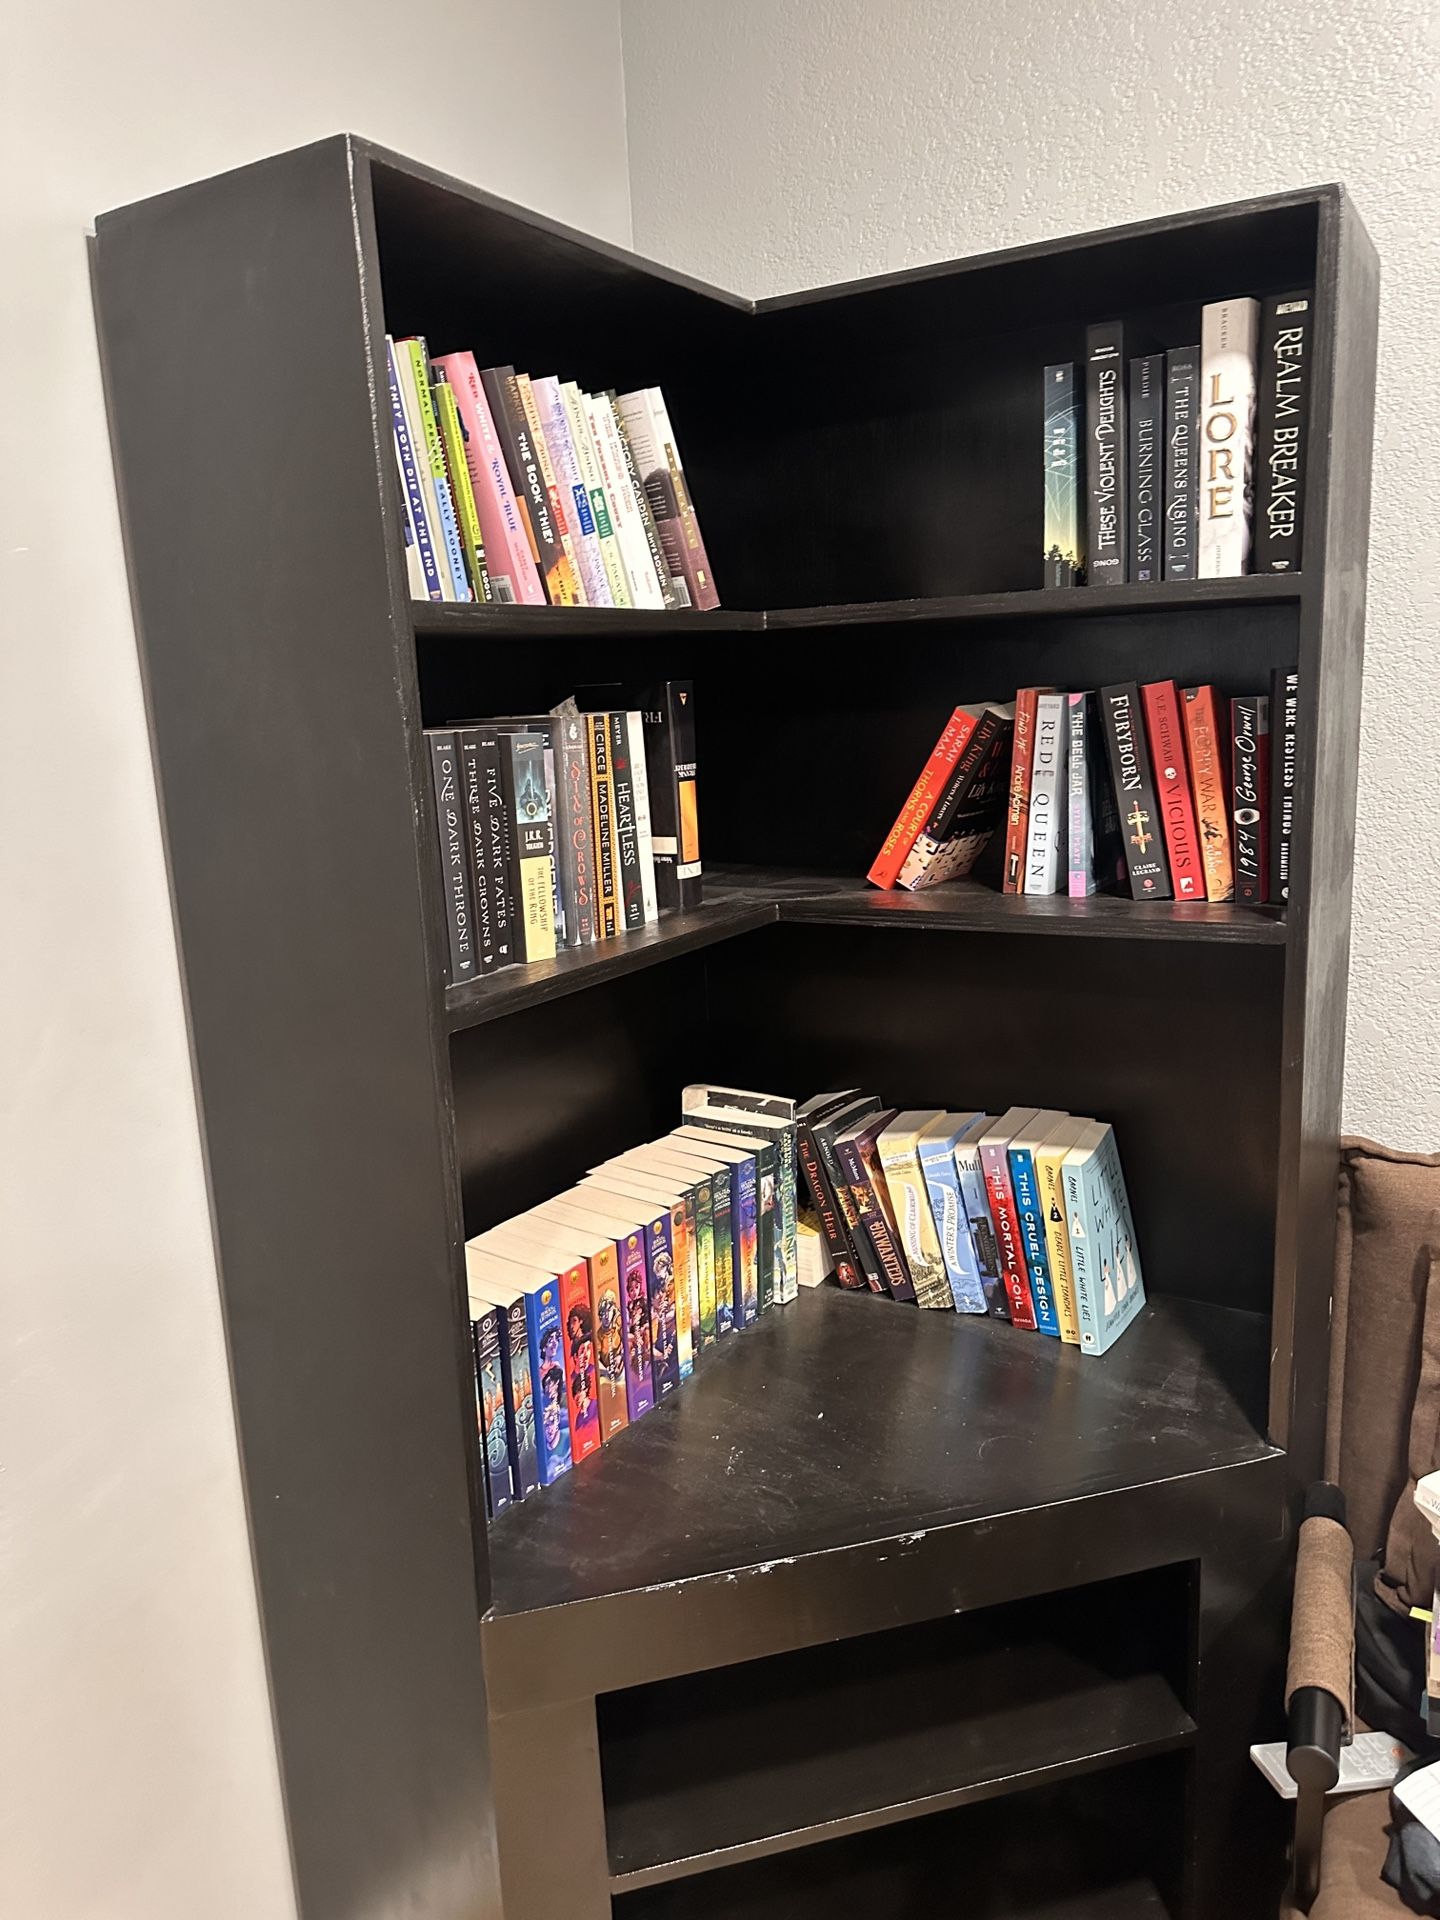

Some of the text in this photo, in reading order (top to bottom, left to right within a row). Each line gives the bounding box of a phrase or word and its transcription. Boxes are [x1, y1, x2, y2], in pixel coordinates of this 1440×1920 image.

[1220, 307, 1228, 350] BRACKEN
[415, 360, 429, 414] NORMAL
[1274, 326, 1304, 418] REALM
[389, 384, 402, 418] THEY
[397, 425, 411, 461] BOTH
[406, 468, 417, 490] DIE
[412, 497, 421, 513] AT
[418, 521, 428, 545] THE
[423, 551, 434, 577] END
[468, 372, 478, 399] RED
[475, 403, 491, 441] WHITE
[491, 457, 507, 499] ROYAL
[503, 500, 517, 532] BLUE
[616, 420, 651, 526] VICTORY GARDEN
[1094, 370, 1117, 550] THESE VIOLENT DELIGHTS
[1166, 386, 1190, 548] THE QUEEN'S RISING
[1205, 373, 1239, 521] LORE
[1267, 426, 1300, 539] BREAKER
[518, 432, 554, 544] THE BOOK THIEF
[1137, 419, 1153, 562] BURNING GLASS
[439, 484, 450, 521] SALLY
[448, 529, 462, 580] ROONEY
[647, 532, 668, 587] RHYS BOWEN
[1286, 673, 1299, 692] WE
[595, 733, 606, 772] CIRCE
[613, 717, 621, 745] MEYER
[935, 726, 956, 760] MAAS
[946, 724, 970, 764] SARAH
[1070, 711, 1084, 796] THE BELL JAR
[1110, 694, 1143, 791] FURYBORN
[1160, 716, 1173, 763] SCHWAB
[1194, 725, 1216, 814] POPPY WAR
[1233, 705, 1257, 802] George Orwell
[486, 767, 503, 808] FIVE
[616, 782, 636, 867] HEARTLESS
[883, 769, 935, 857] THORNS ROSES
[907, 790, 935, 840] A COURT
[1010, 764, 1026, 826] André Aciman
[1031, 720, 1055, 878] RED QUEEN
[1166, 783, 1191, 868] VICIOUS
[441, 759, 469, 953] ONE DARK THRONE
[467, 758, 491, 948] THREE DARK CROWNS
[490, 813, 503, 868] DARK
[573, 828, 589, 906] CROWS
[598, 784, 613, 894] MADELINE MILLER
[1132, 867, 1161, 876] LEGRAND
[1205, 844, 1217, 875] KUANG
[1237, 832, 1257, 877] 1984
[494, 876, 507, 929] FATES
[530, 900, 539, 925] RING
[538, 882, 549, 932] FELLOWSHIP
[800, 1141, 810, 1159] THE
[807, 1161, 827, 1208] DRAGON
[822, 1210, 838, 1240] HEIR
[820, 1137, 834, 1165] ARNOLD
[1046, 1164, 1055, 1192] BARNES
[1069, 1175, 1078, 1204] BARNES
[869, 1220, 906, 1286] UNWANTEDS
[944, 1190, 956, 1262] WINTER'S PROMISE
[991, 1166, 1024, 1309] THIS MORTAL COIL
[1018, 1174, 1050, 1322] THIS CRUEL DESIGN
[1054, 1230, 1065, 1261] DEADLY
[1062, 1283, 1073, 1319] SCANDALS
[1076, 1246, 1092, 1322] LITTLE WHITE LIES
